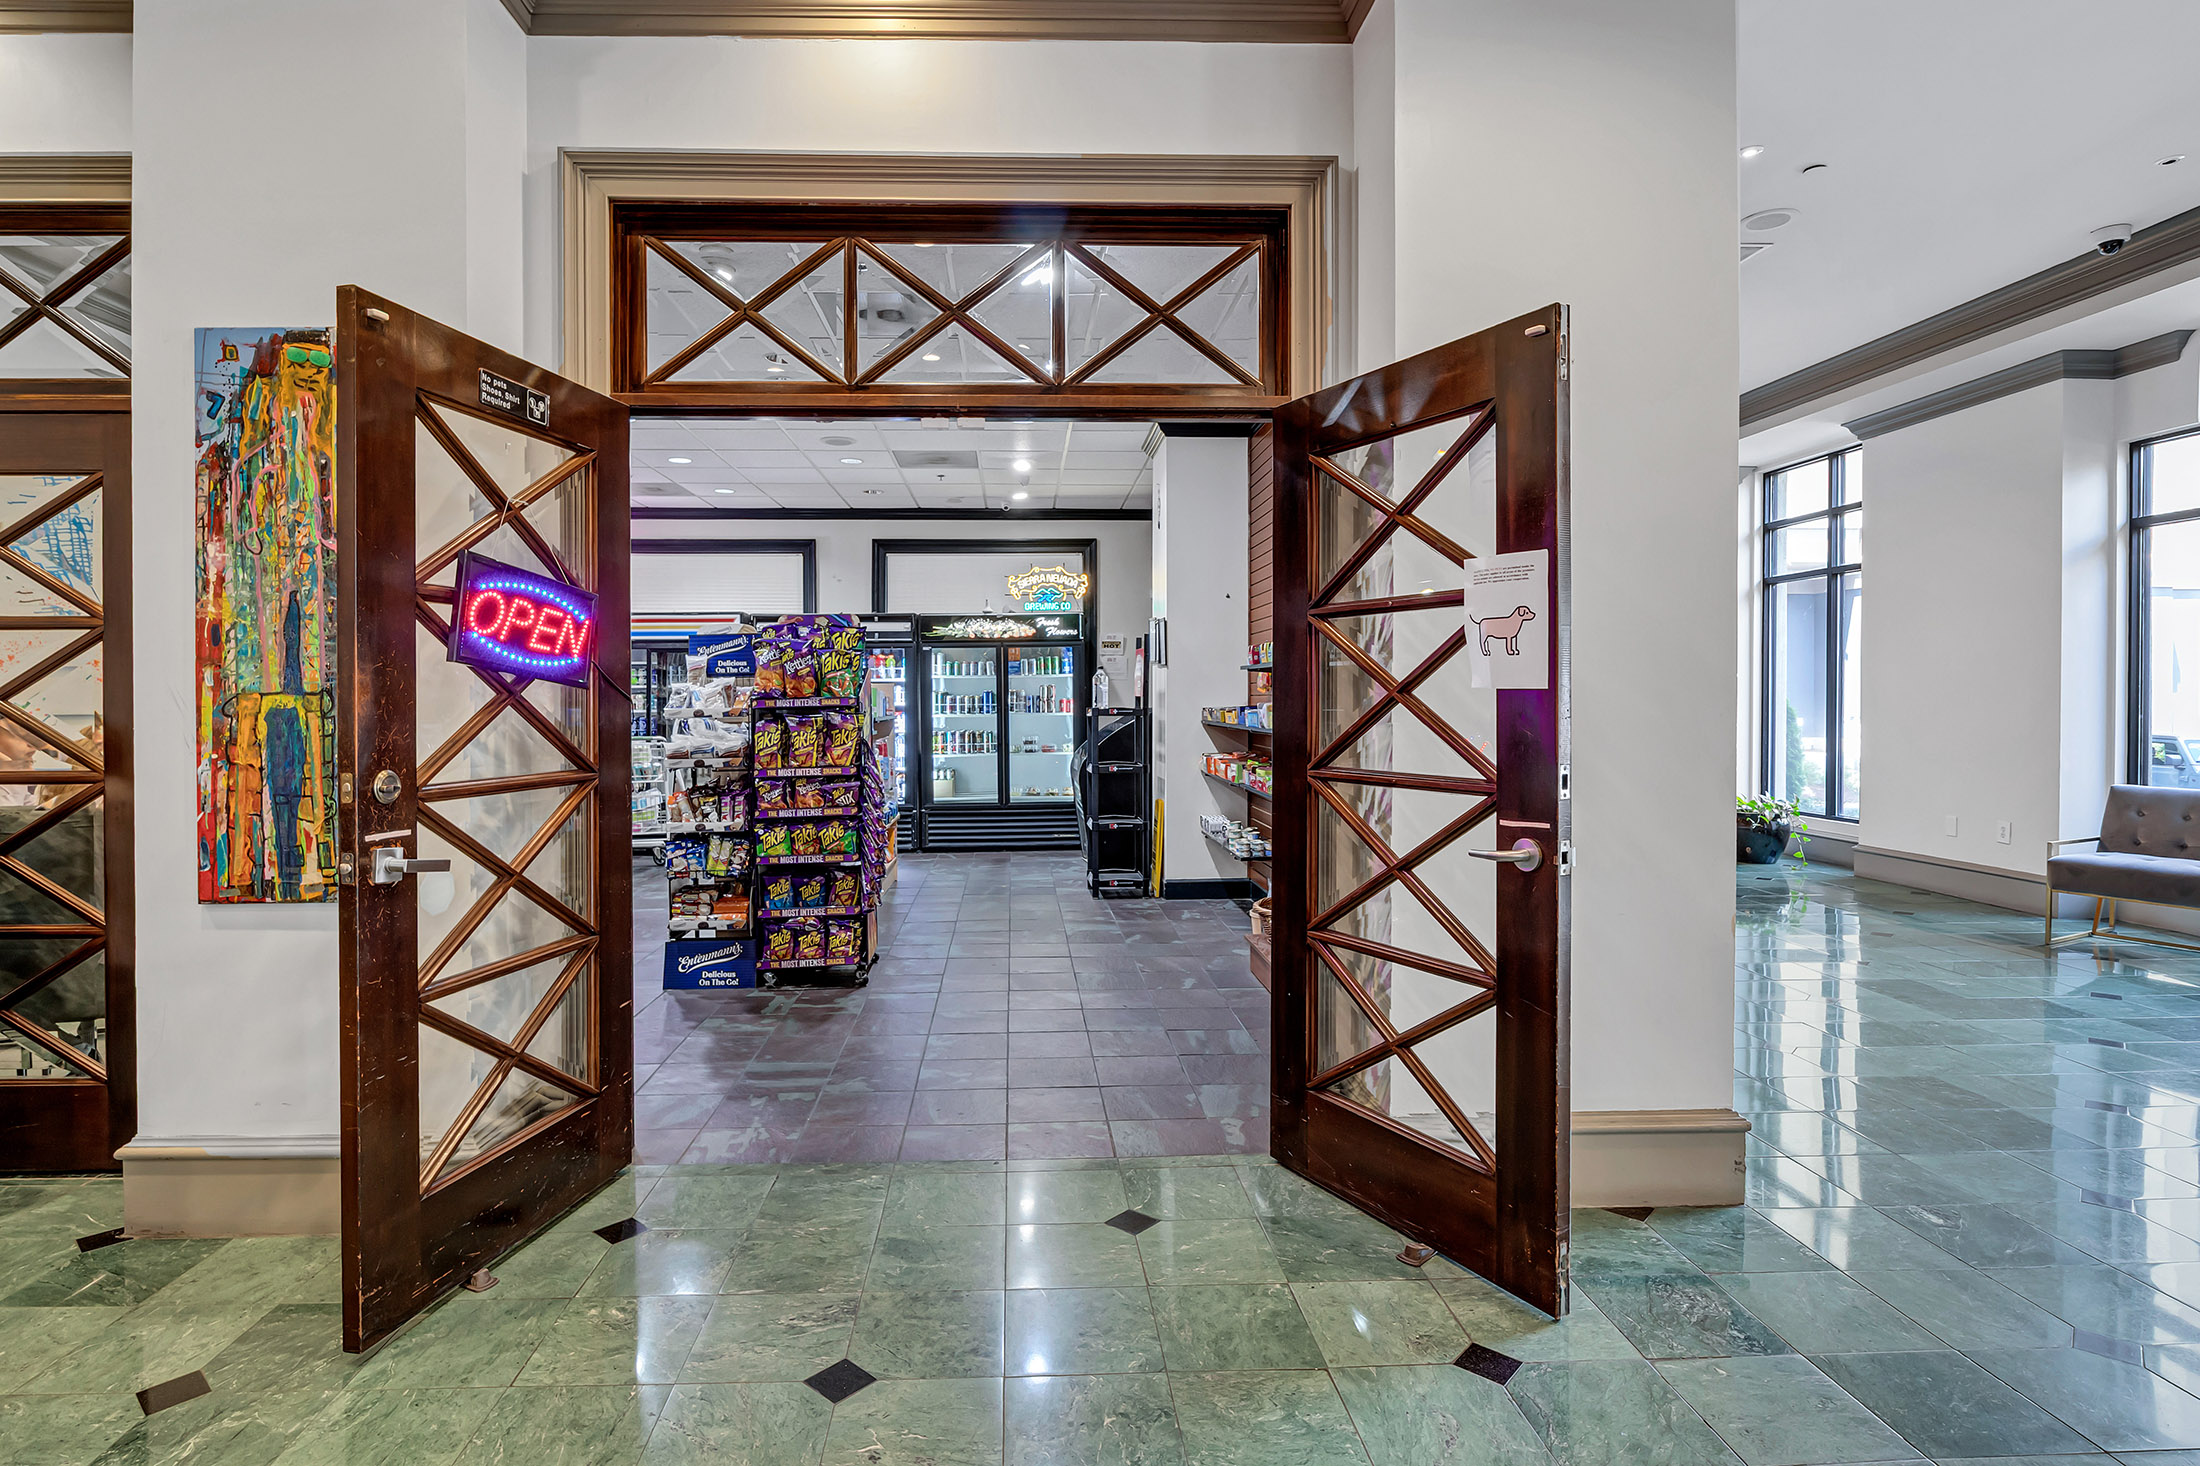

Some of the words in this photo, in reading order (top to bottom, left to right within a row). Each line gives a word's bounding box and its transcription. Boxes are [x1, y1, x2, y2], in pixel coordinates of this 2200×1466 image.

[482, 373, 491, 383] No
[493, 379, 507, 389] pets
[482, 392, 511, 409] Required
[505, 392, 520, 404] Shirt
[1017, 574, 1046, 589] SIERRA
[1046, 574, 1078, 588] NEVADA
[1024, 602, 1059, 611] BREWING
[1060, 602, 1071, 611] CO
[469, 591, 590, 657] OPEN
[1035, 617, 1060, 627] Fresh
[1045, 627, 1078, 637] Flowers
[697, 635, 747, 657] Entenmann's
[832, 632, 862, 650] Takis
[759, 650, 781, 665] Kettle
[784, 655, 814, 675] Kettlez
[822, 651, 851, 677] Takis
[794, 698, 820, 706] INTENSE
[754, 730, 781, 754] Takis
[791, 730, 816, 752] Takis
[831, 728, 858, 748] Takis
[796, 768, 821, 776] INTENSE
[835, 791, 855, 806] STIX
[779, 809, 796, 817] MOST
[797, 808, 822, 816] INTENSE
[760, 829, 786, 852] Takis
[791, 827, 818, 849] Takis
[818, 825, 844, 849] Takis
[780, 856, 797, 864] MOST
[798, 855, 824, 863] INTENSE
[768, 880, 790, 900] Takis
[799, 882, 821, 901] Takis
[835, 879, 855, 894] Takis
[769, 931, 791, 949] Takis
[798, 933, 821, 952] Takis
[829, 935, 849, 950] Takis
[678, 942, 740, 973] Entenmann's
[781, 960, 798, 968] MOST
[800, 959, 825, 967] INTENSE
[726, 978, 739, 986] Go!
